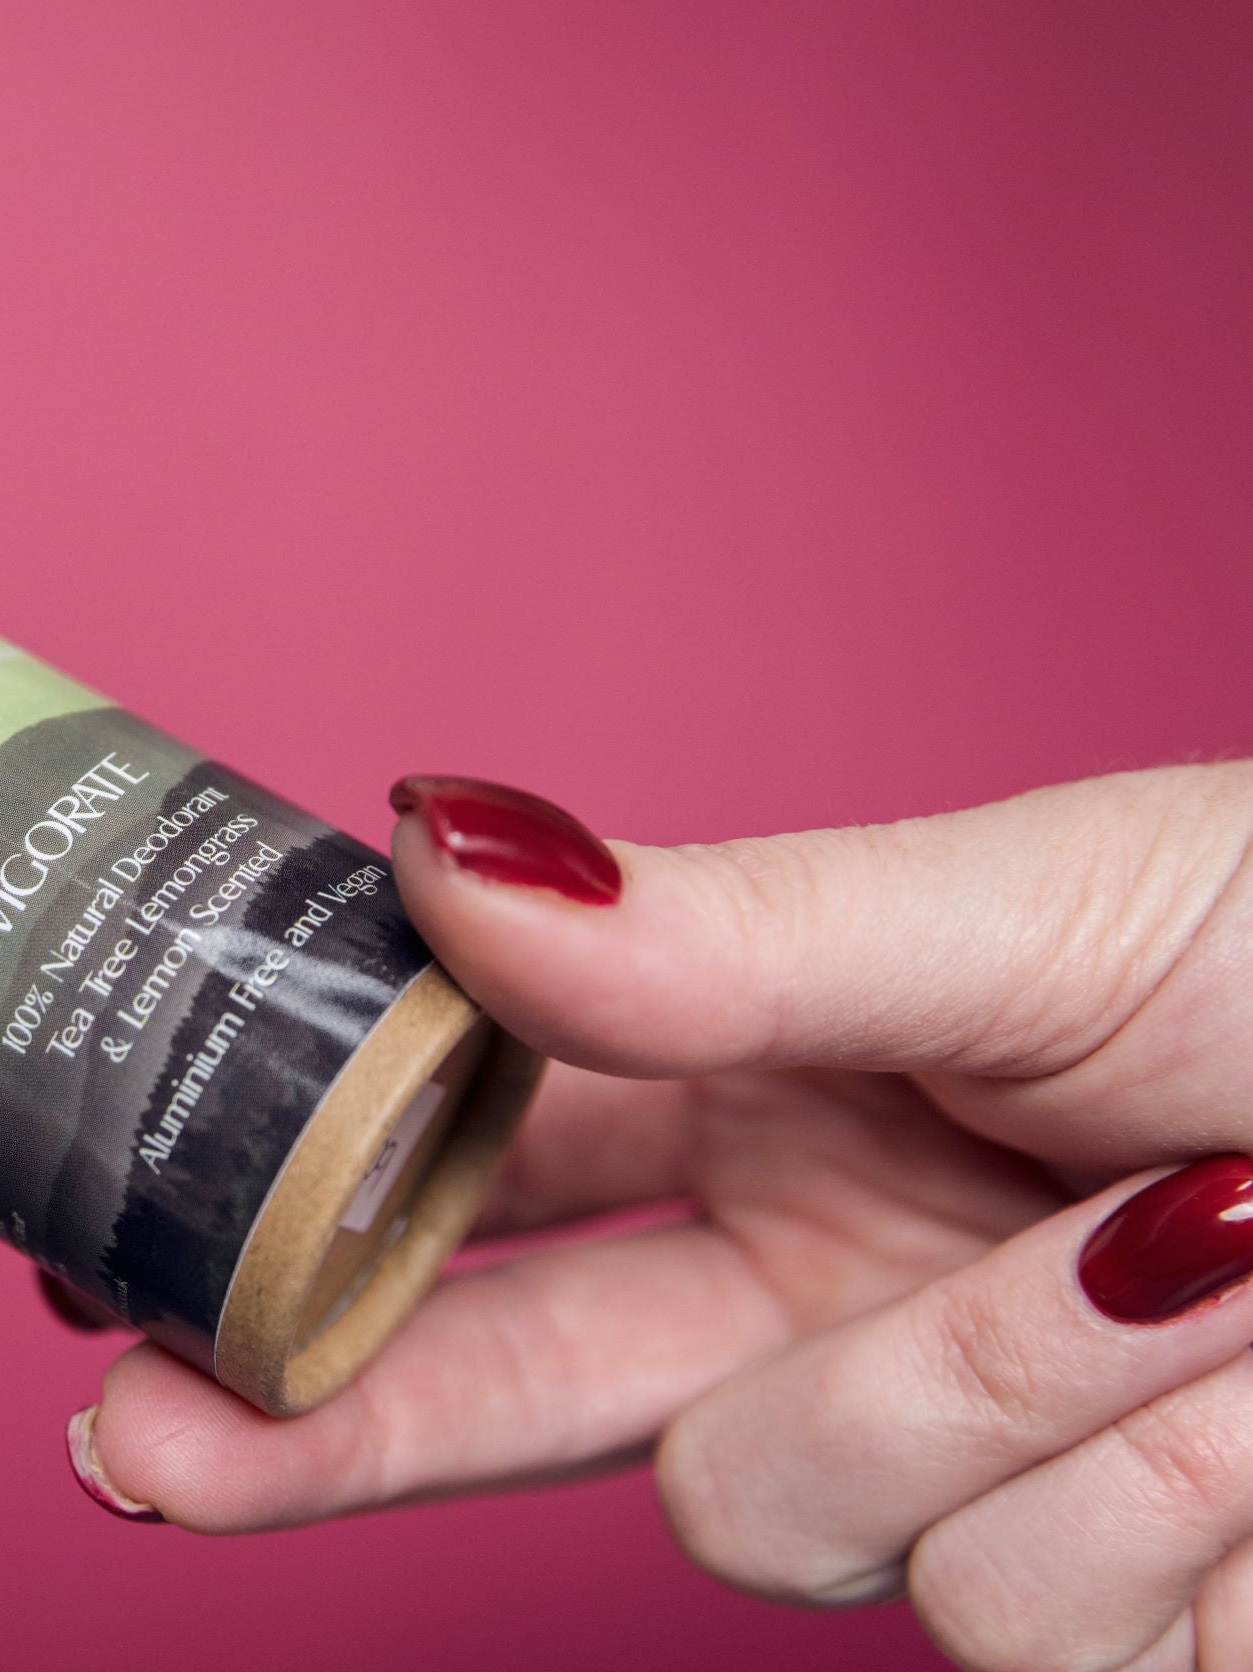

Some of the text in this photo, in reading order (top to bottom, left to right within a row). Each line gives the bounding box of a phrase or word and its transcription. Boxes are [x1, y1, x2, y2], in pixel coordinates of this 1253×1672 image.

[2, 786, 229, 1055] 100% Natural Deodorant
[46, 813, 258, 1059] Tea Tree Lemongrass
[100, 841, 284, 1064] & Lemon Scented
[137, 863, 388, 1176] Aluminium Free and Vegan
